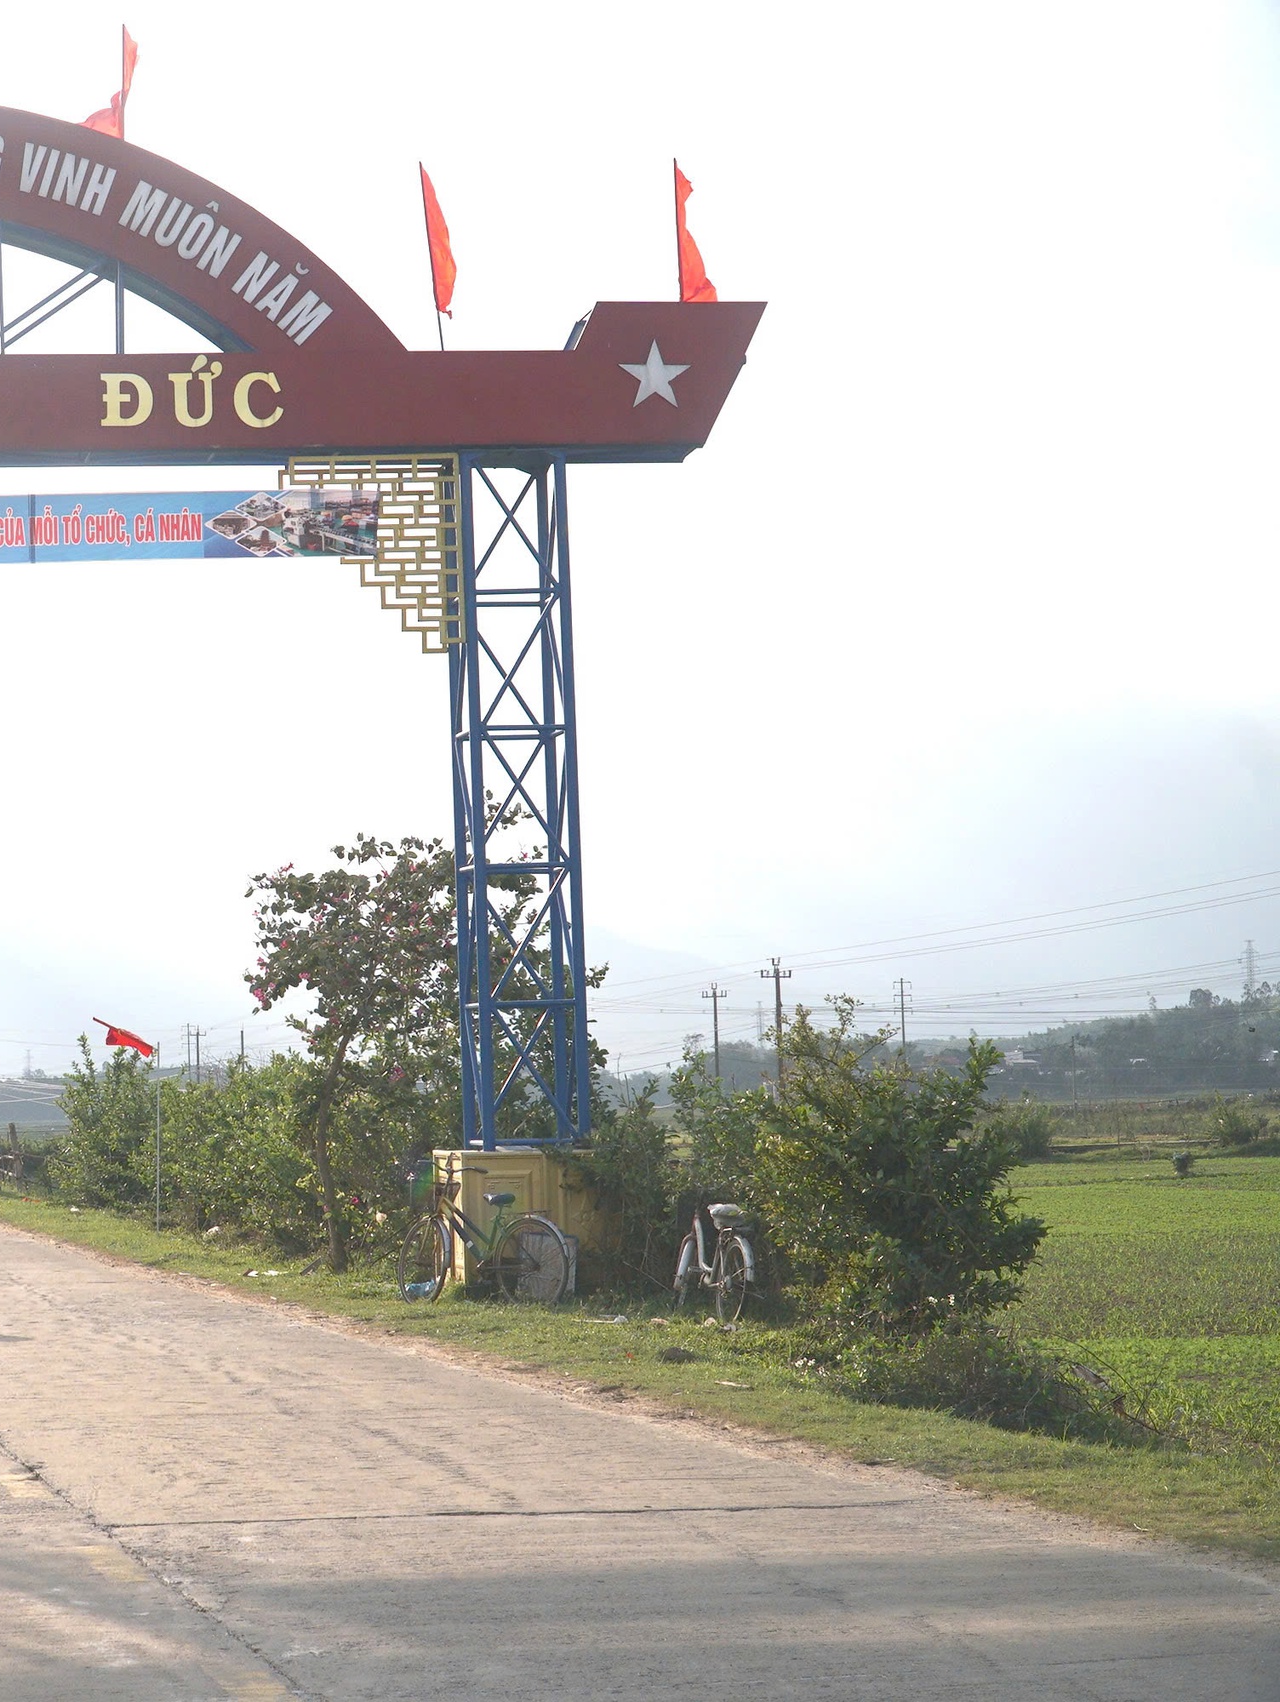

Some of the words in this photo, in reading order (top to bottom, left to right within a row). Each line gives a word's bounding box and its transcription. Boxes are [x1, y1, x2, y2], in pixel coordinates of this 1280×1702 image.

[20, 142, 116, 216] VINH
[118, 180, 243, 279] MUÔN
[231, 250, 334, 346] NĂM
[100, 354, 285, 428] ĐỨC
[28, 505, 59, 546] MỖI
[61, 503, 82, 545] TỔ
[85, 507, 131, 547] CHỨC,
[134, 507, 156, 543] CÁ
[159, 506, 202, 543] NHÂN
